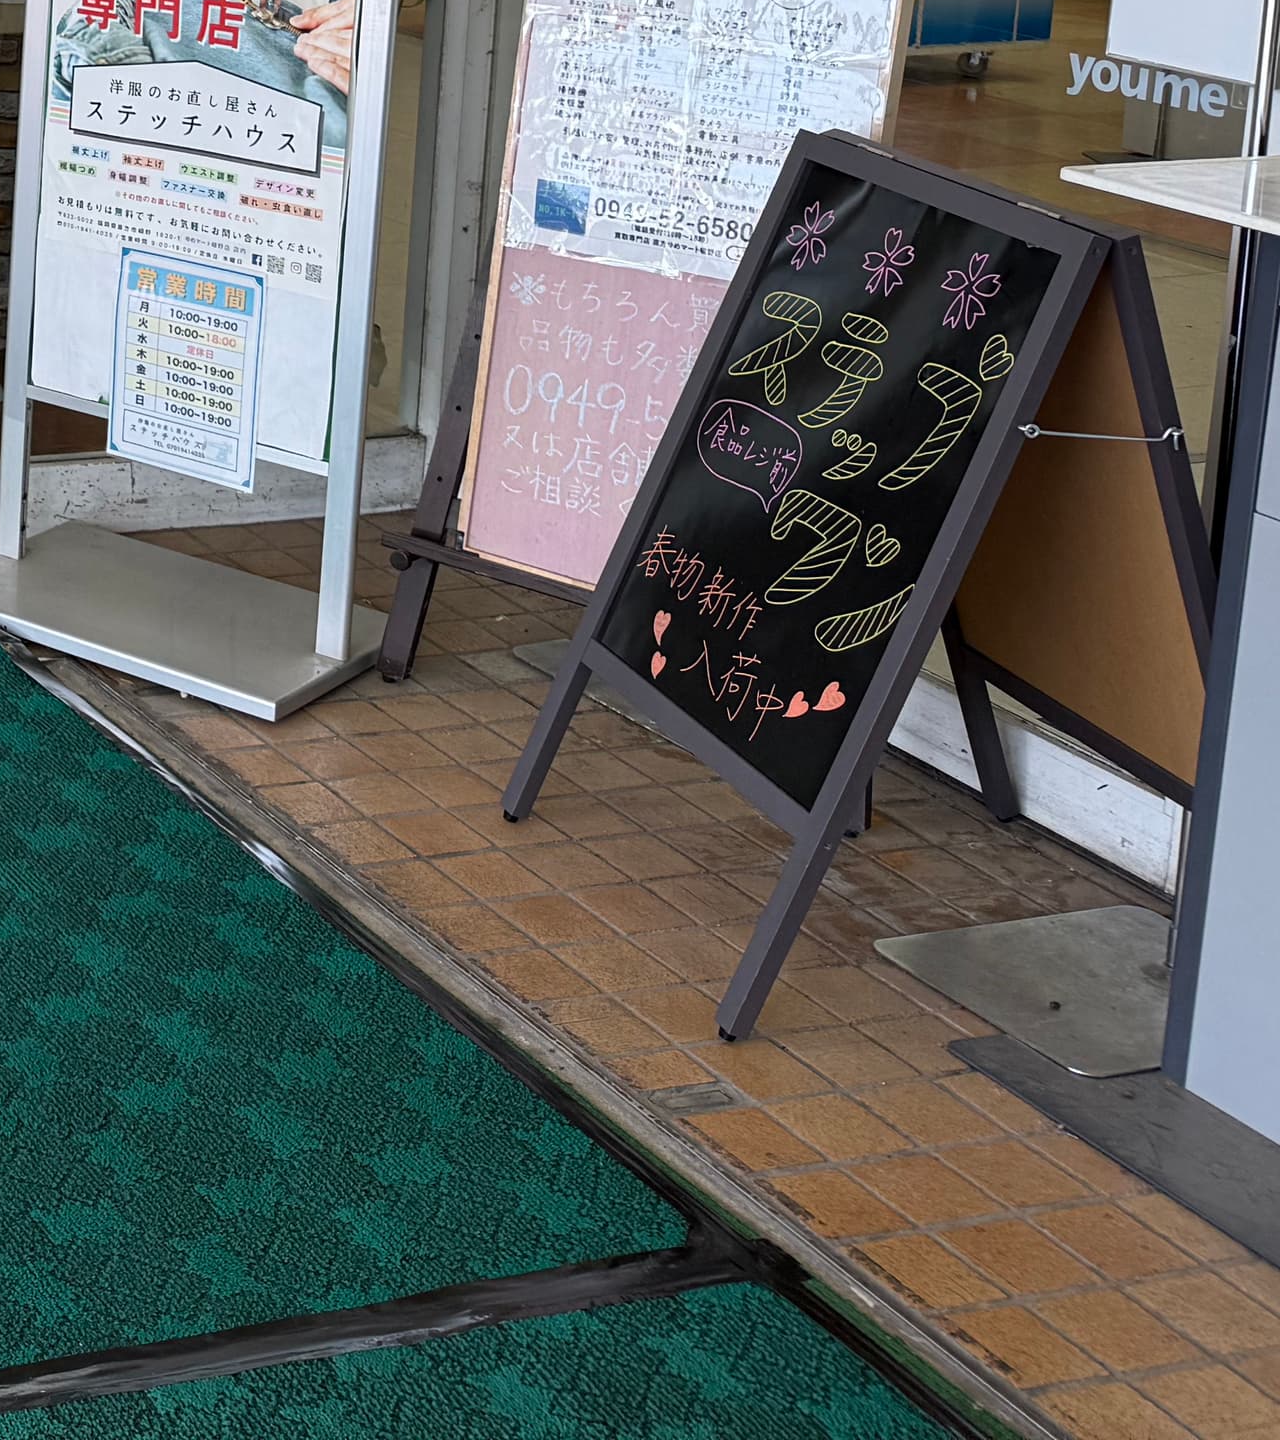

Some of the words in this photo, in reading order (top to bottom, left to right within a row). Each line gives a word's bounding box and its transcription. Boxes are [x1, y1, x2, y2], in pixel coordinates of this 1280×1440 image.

[1066, 52, 1229, 118] youme
[108, 78, 279, 120] 洋服のお直し屋さん
[86, 100, 298, 154] ステッチハウス
[255, 179, 316, 199] デザイン変更
[137, 267, 246, 312] 営業時間
[139, 300, 150, 313] 月
[138, 316, 149, 329] 火
[137, 333, 148, 345] 水
[136, 347, 148, 360] 木
[136, 363, 147, 376] 金
[135, 378, 146, 391] 土
[135, 394, 145, 406] 日
[703, 406, 798, 494] 食品レジ前
[637, 524, 763, 642] 春物新作
[680, 638, 785, 742] 入荷中
